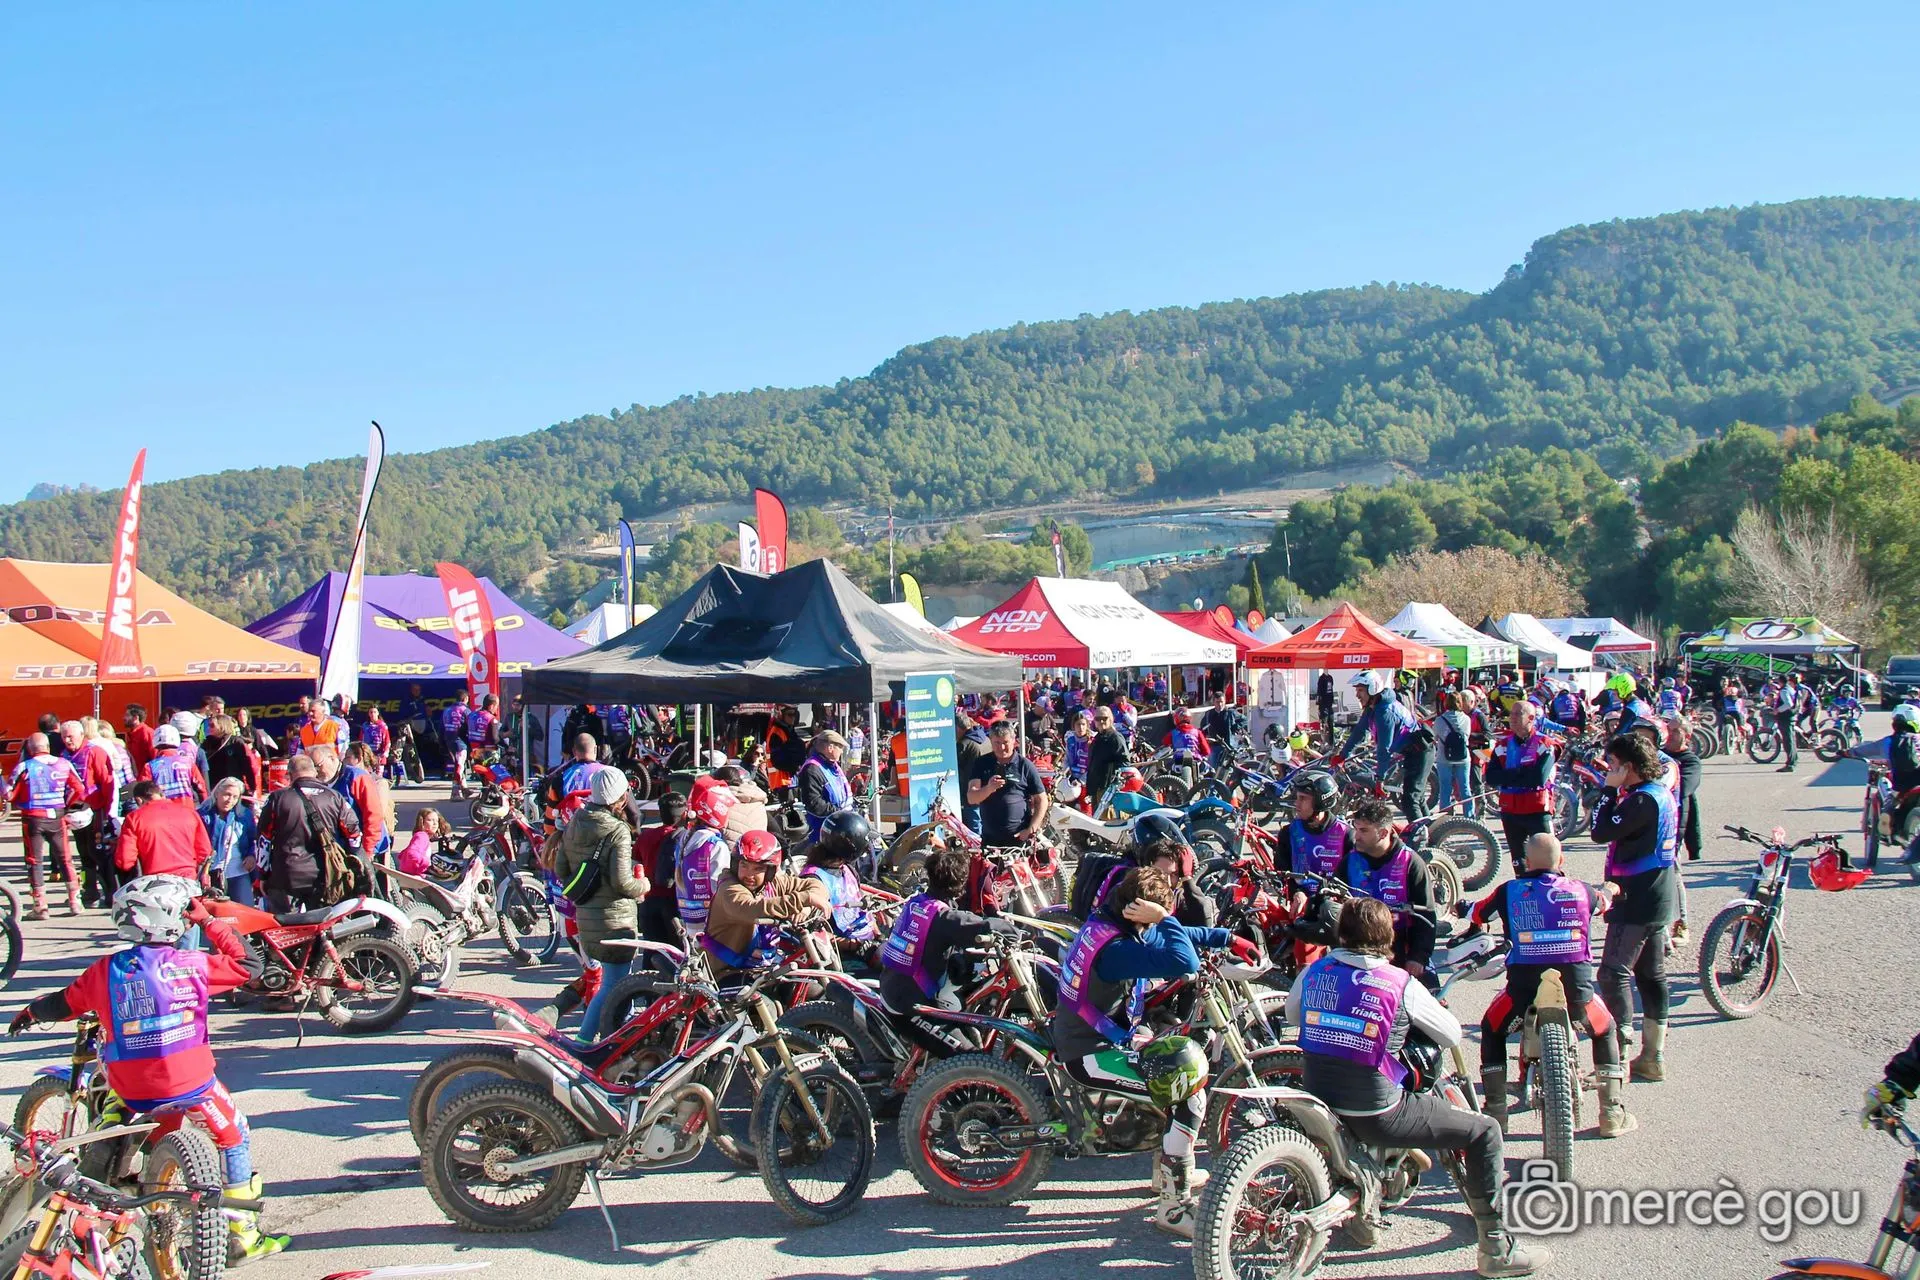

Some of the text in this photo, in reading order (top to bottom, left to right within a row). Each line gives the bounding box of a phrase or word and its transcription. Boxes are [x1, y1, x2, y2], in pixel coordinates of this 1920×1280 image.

[109, 480, 141, 640] MOTUL
[986, 609, 1048, 624] NON
[978, 623, 1042, 634] STOP
[358, 662, 434, 675] HERCO
[1361, 991, 1380, 1005] fcm
[1351, 1006, 1383, 1022] TrialGo
[1321, 1015, 1331, 1023] La
[1331, 1016, 1361, 1030] Marató
